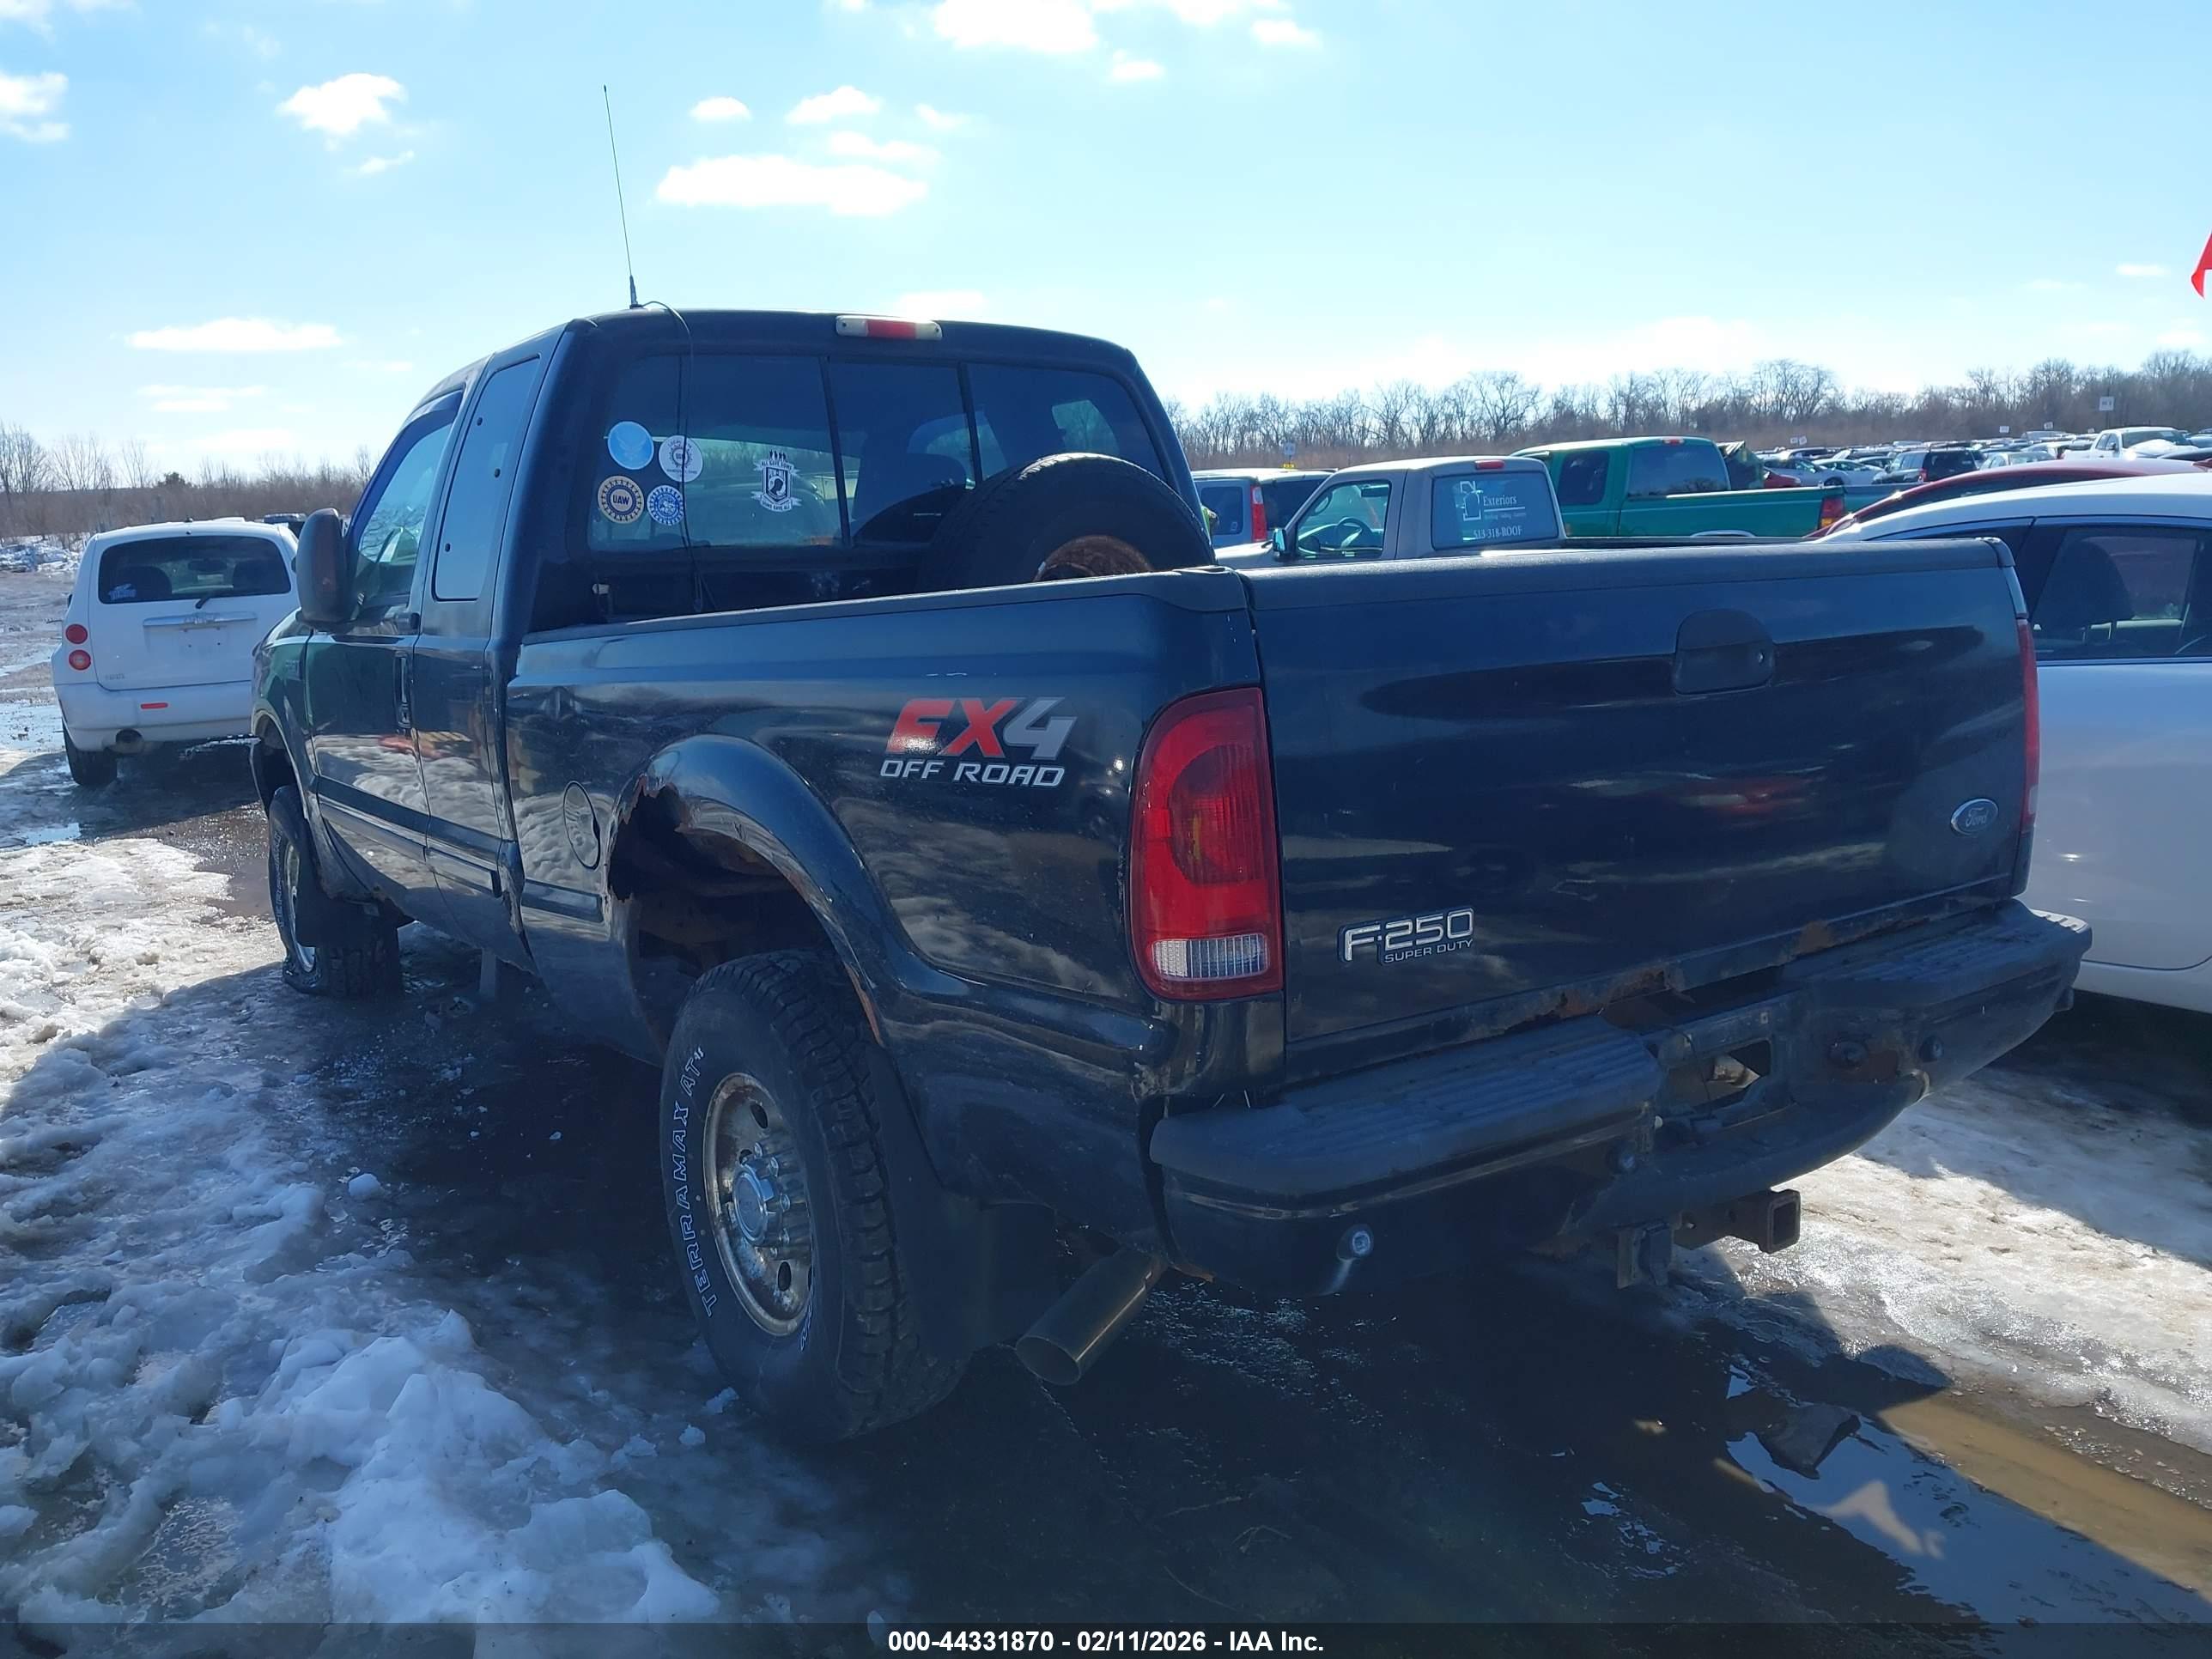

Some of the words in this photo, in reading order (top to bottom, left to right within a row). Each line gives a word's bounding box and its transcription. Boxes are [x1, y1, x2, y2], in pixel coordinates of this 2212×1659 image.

[612, 494, 630, 506] UAW
[1483, 495, 1517, 506] Exteriors
[885, 696, 1078, 760] FX4
[879, 759, 945, 779] OFF
[953, 763, 1066, 787] ROAD
[1384, 947, 1433, 963] SUPER
[1437, 938, 1474, 954] DUTY
[672, 1099, 719, 1317] TERRAMAX
